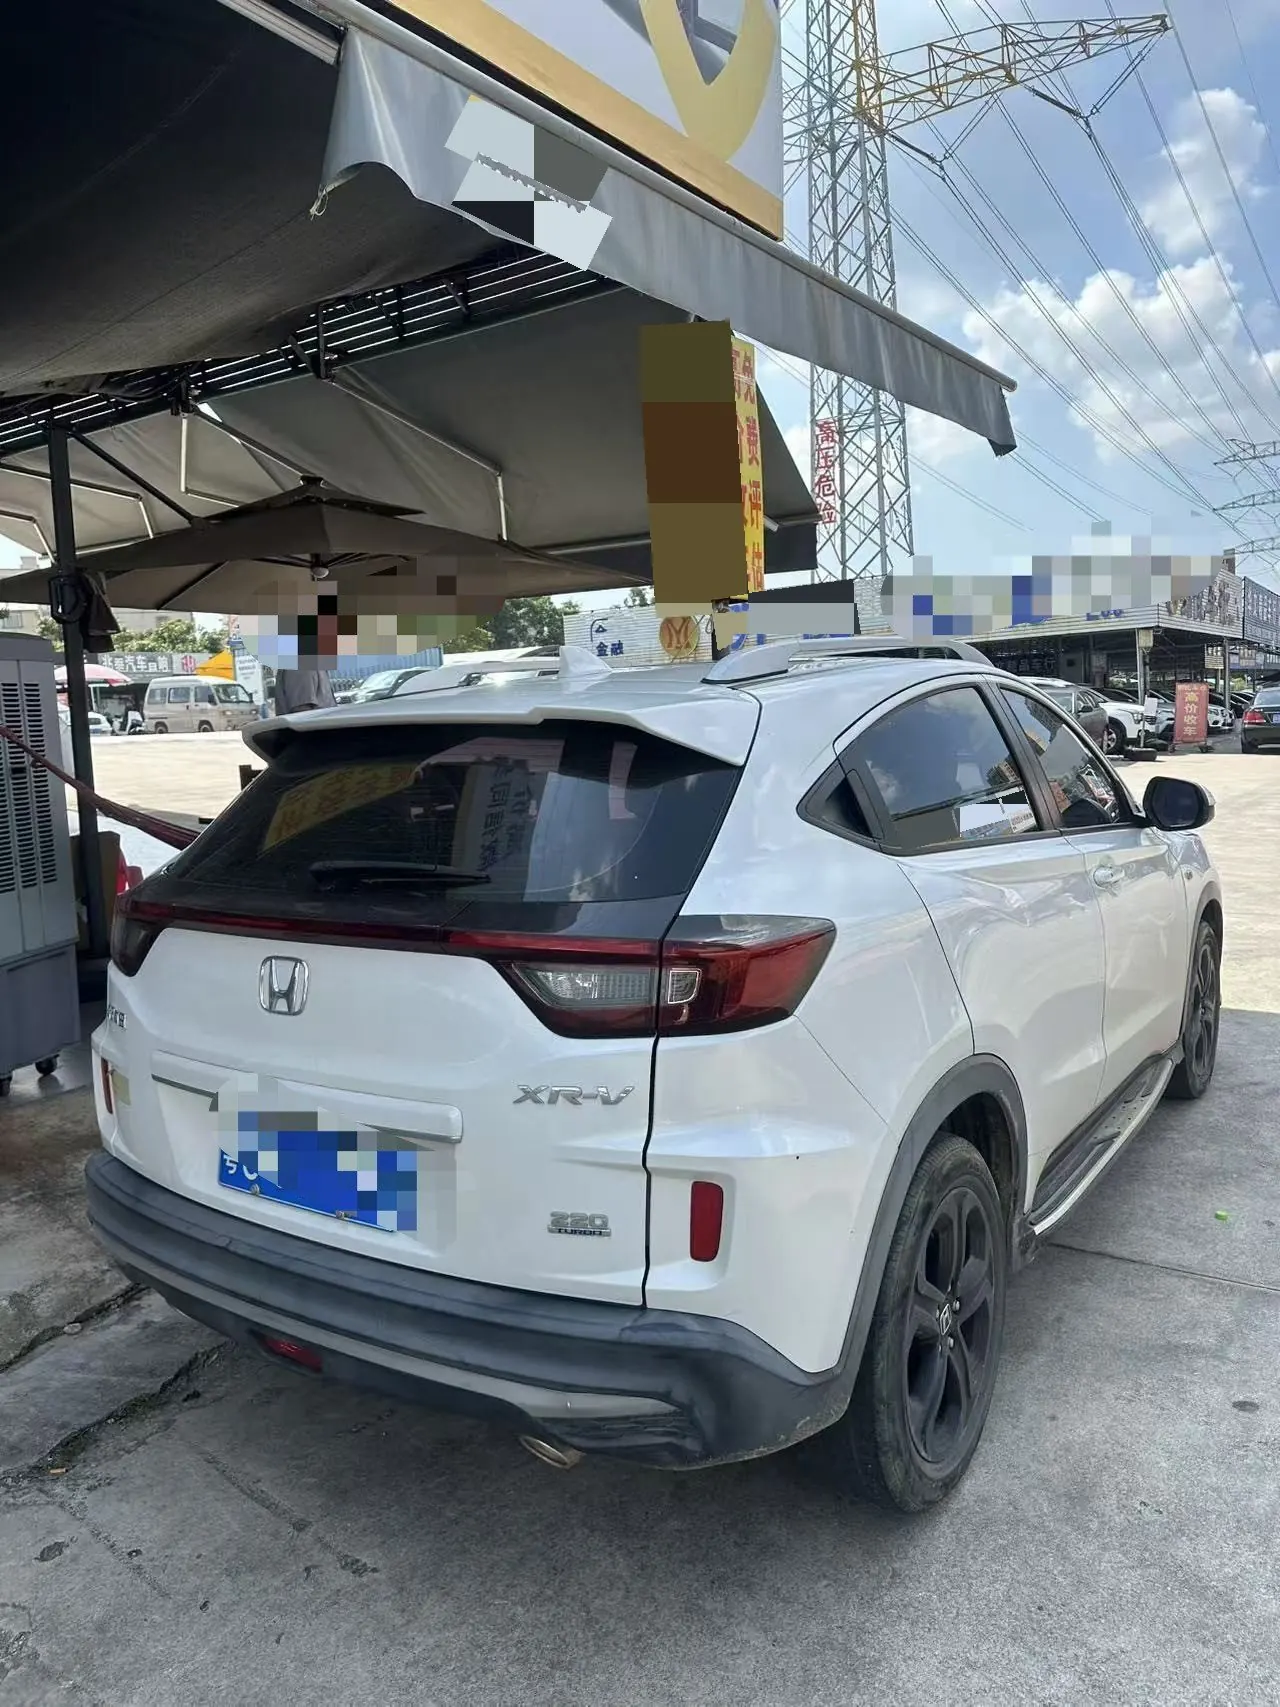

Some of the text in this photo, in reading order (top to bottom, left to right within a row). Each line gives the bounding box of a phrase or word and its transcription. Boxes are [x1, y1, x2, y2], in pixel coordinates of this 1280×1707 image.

[814, 420, 837, 523] 高压危险
[596, 640, 624, 656] 金融
[1183, 692, 1199, 735] 高价收车
[512, 1084, 635, 1106] XR-V
[550, 1211, 609, 1228] 220
[557, 1227, 603, 1236] TURBO
